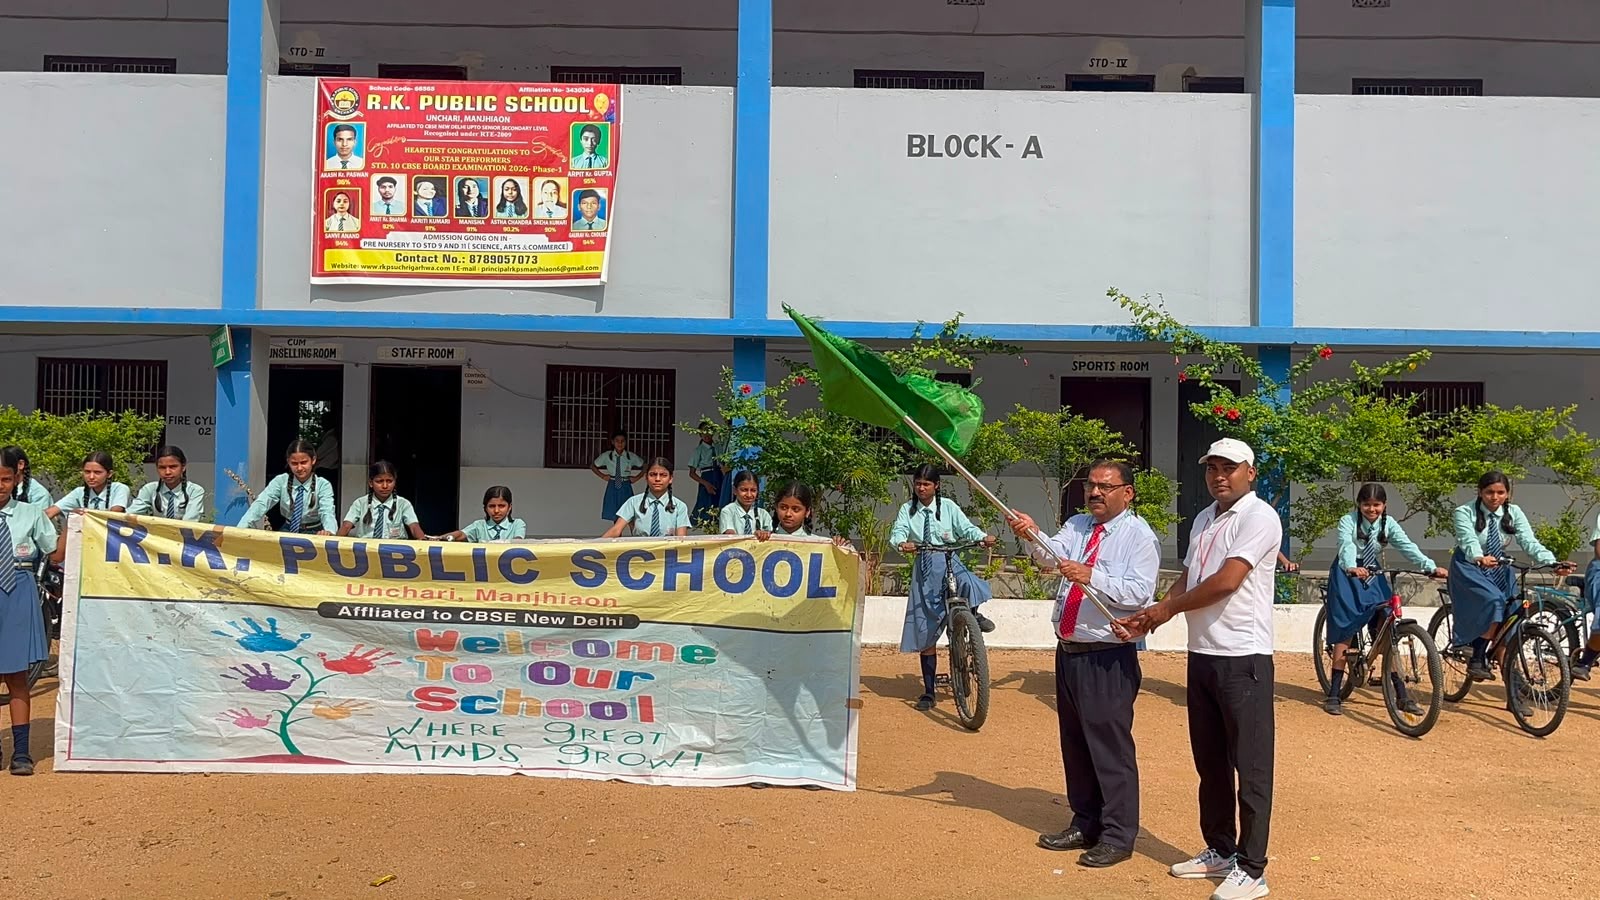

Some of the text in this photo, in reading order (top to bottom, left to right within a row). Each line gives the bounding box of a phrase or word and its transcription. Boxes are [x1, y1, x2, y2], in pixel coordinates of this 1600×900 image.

[366, 94, 591, 114] R.K. PUBLIC SCHOOL
[425, 114, 511, 123] UNCHARI, MANJHIAON
[404, 146, 445, 154] HEARTIEST
[447, 147, 519, 155] CONGRATULATIONS
[1021, 135, 1044, 159] A
[441, 155, 460, 163] STAR
[461, 156, 511, 164] PERFORMERS
[422, 163, 449, 171] BOARD
[452, 164, 507, 172] EXAMINATION
[464, 234, 487, 242] GOING
[411, 241, 422, 249] TO
[395, 253, 538, 265] Contact No.: 8789057073
[287, 338, 306, 346] CUM
[313, 348, 337, 359] ROOM
[391, 347, 455, 359] STAFF ROOM
[1072, 360, 1149, 372] SPORTS ROOM
[168, 415, 191, 425] FIRE
[198, 427, 212, 436] 02
[104, 518, 838, 599] R.K. PUBLIC SCHOOL
[346, 583, 619, 609] Unchari, Manjhiaon
[337, 605, 624, 628] Affliated to CBSE New Delhi
[411, 628, 719, 665] Welcome
[411, 655, 656, 691] To Our
[409, 686, 656, 724] School
[386, 717, 507, 738] WHERE
